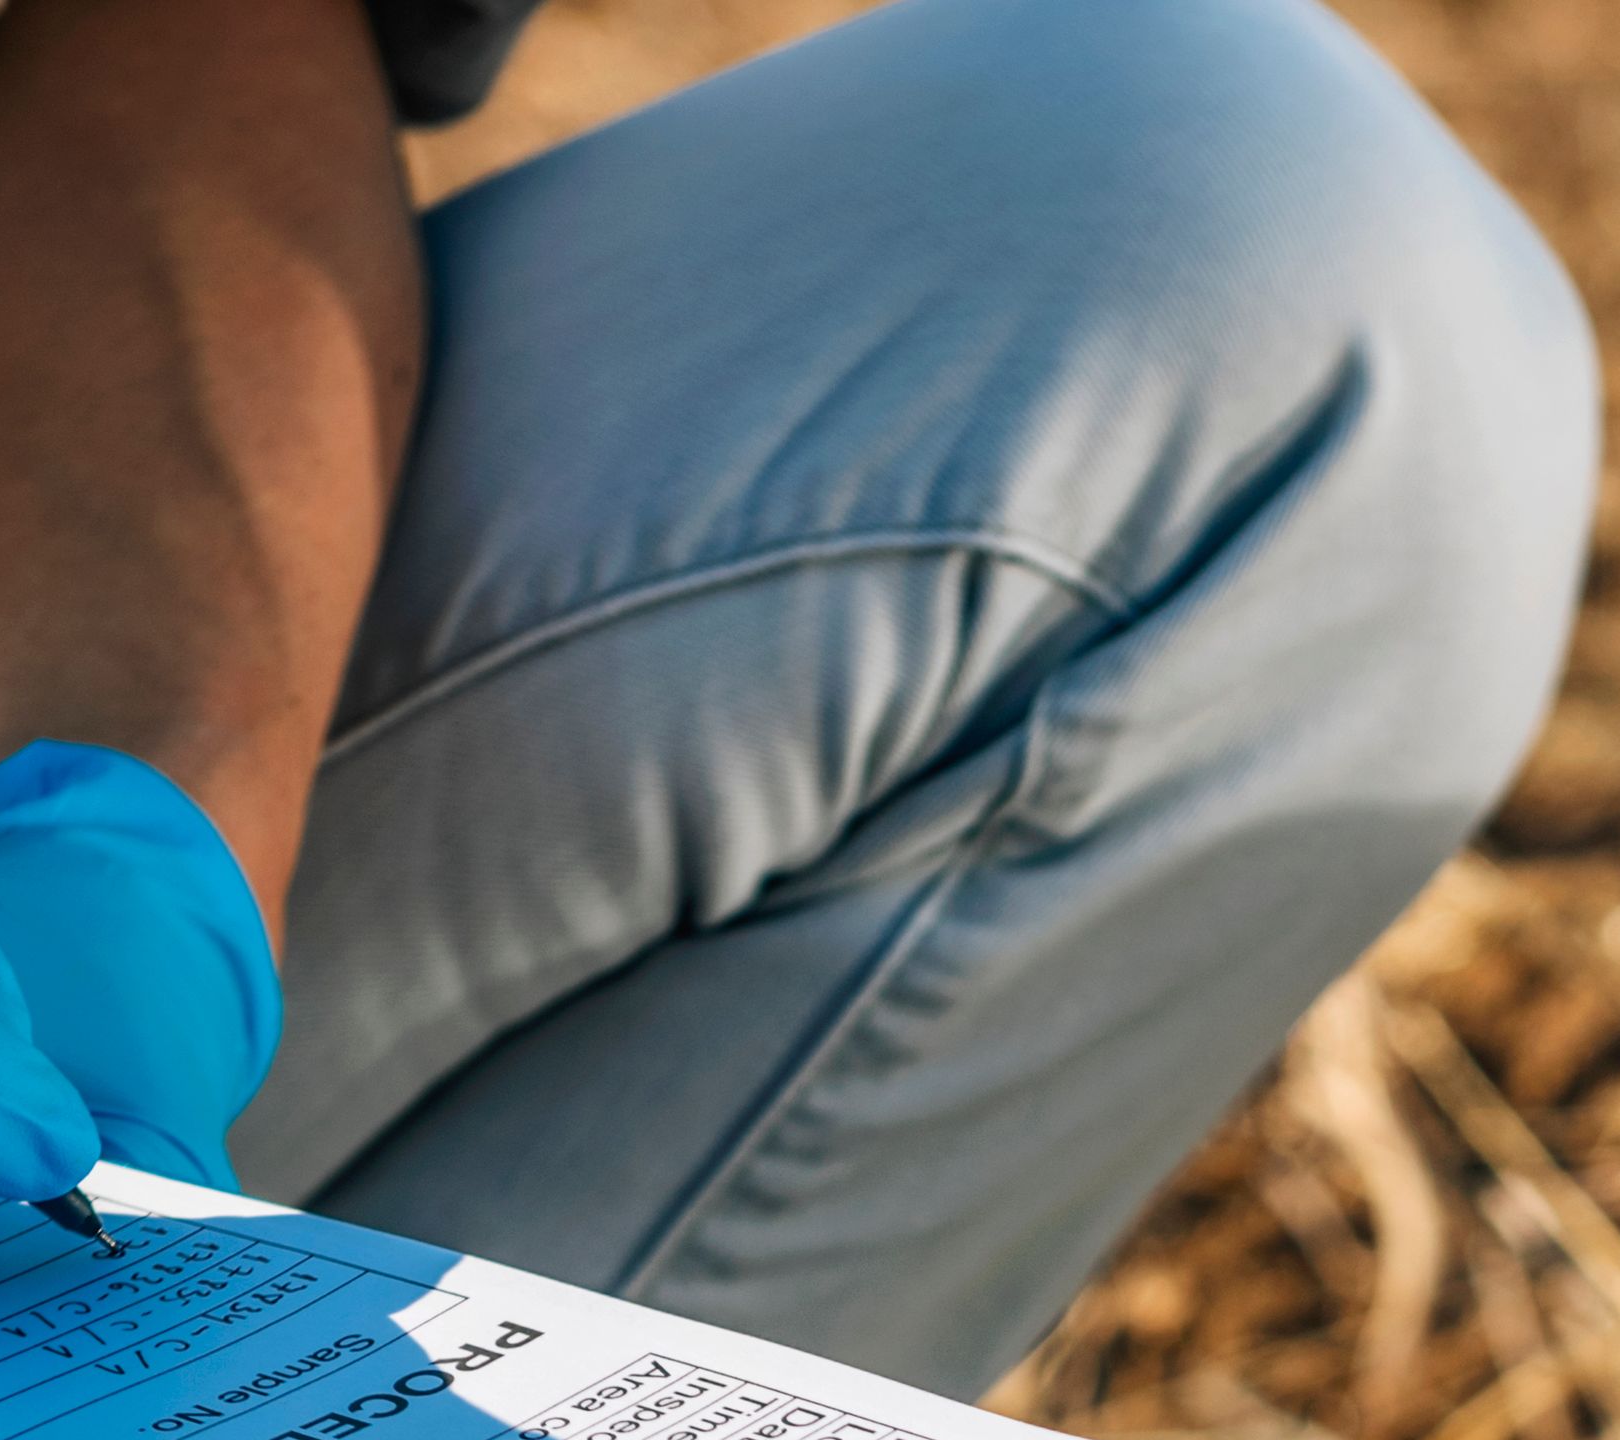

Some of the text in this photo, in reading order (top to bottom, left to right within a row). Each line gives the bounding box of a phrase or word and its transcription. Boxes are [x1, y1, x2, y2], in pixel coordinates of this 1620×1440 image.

[136, 1332, 374, 1433] Sample No.
[569, 1358, 670, 1417] Area
